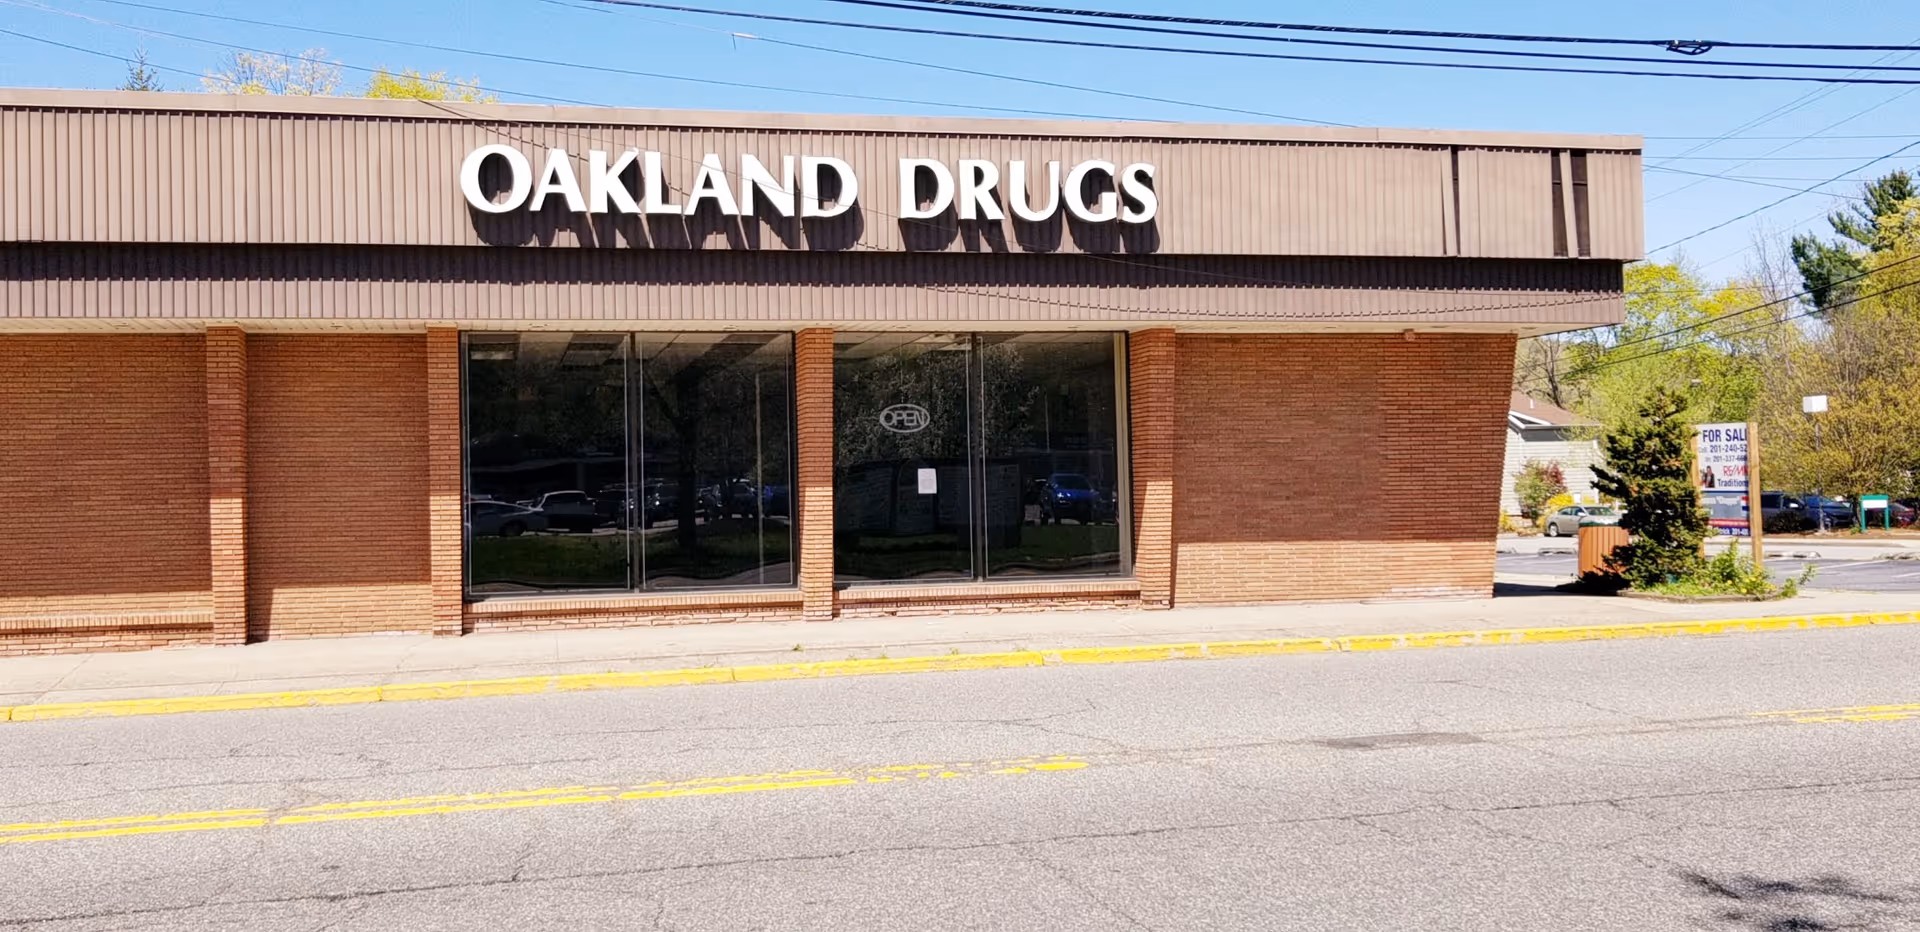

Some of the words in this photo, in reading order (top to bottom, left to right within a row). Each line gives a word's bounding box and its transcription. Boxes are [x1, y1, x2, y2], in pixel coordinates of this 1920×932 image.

[460, 144, 858, 217] OAKLAND
[899, 157, 1159, 223] DRUGS
[882, 410, 925, 426] OPEN
[1702, 429, 1721, 442] FOR
[1710, 443, 1747, 453] 201-240-52
